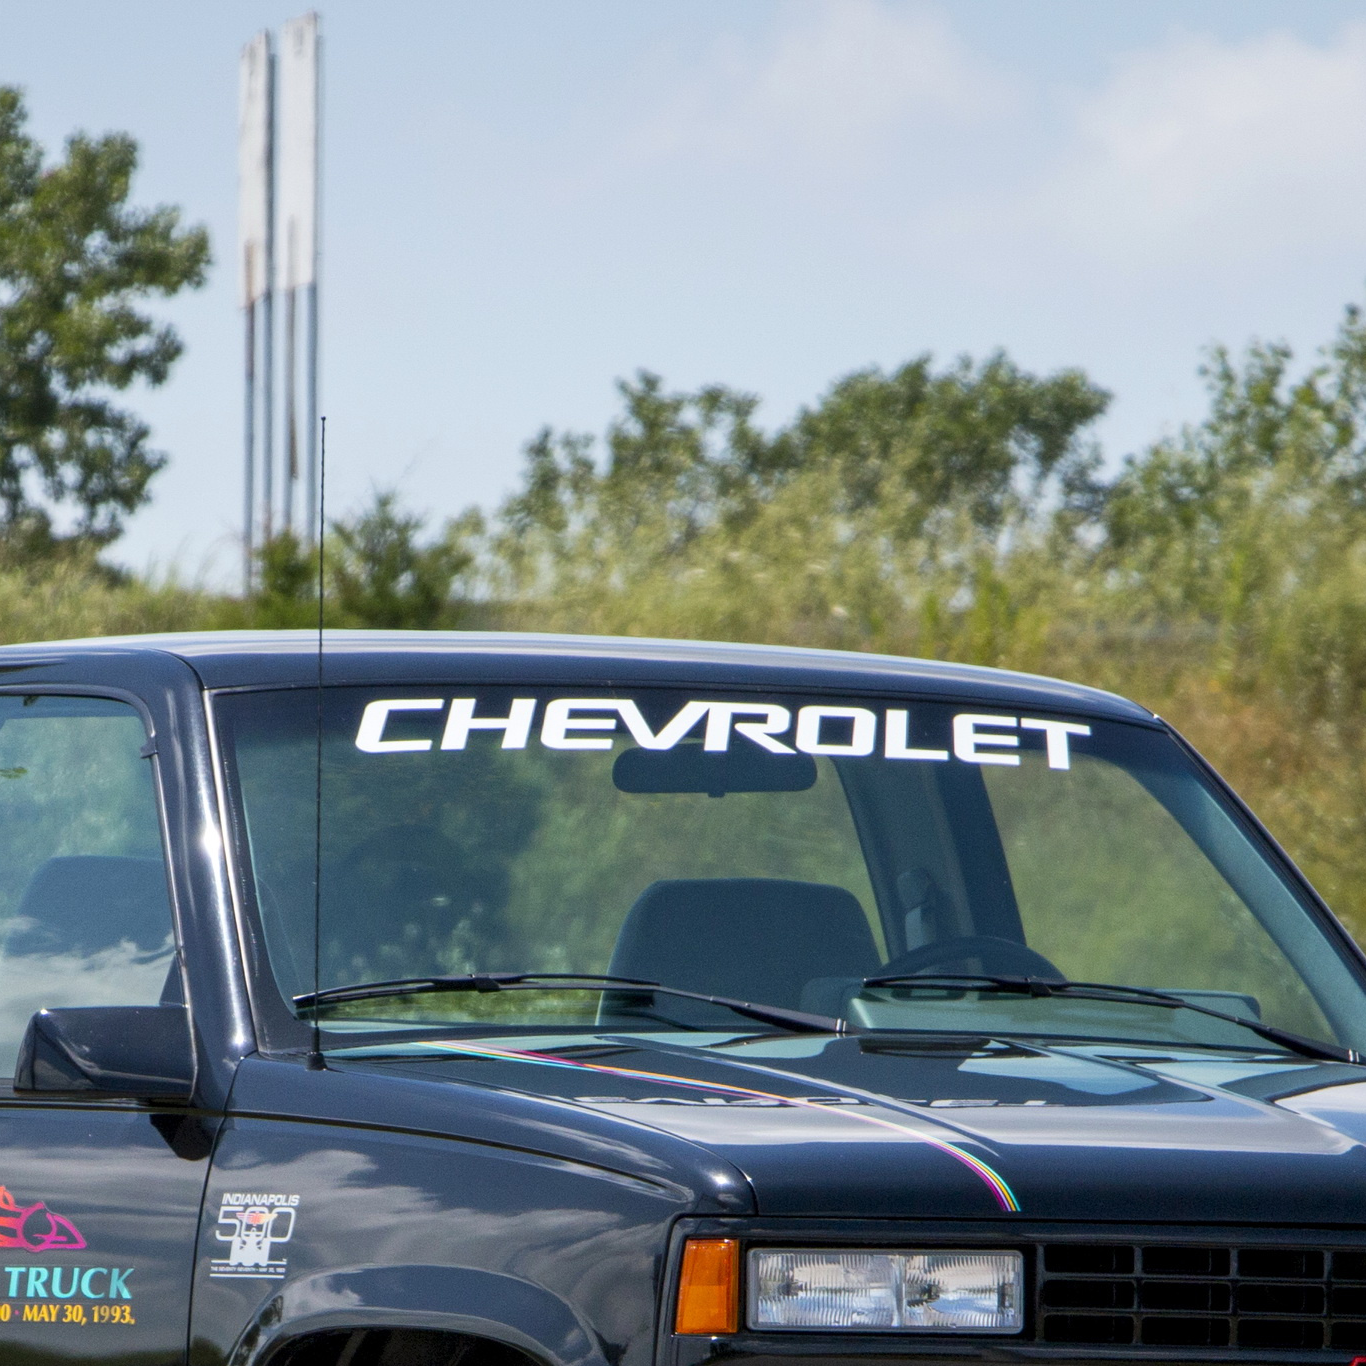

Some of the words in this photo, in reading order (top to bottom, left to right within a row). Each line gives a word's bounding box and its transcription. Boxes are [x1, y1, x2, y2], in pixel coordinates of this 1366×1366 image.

[355, 697, 1092, 770] CHEVROLET
[221, 1192, 300, 1206] INDIANAPOLIS
[215, 1206, 296, 1243] 500
[4, 1266, 135, 1299] TRUCK
[22, 1304, 61, 1323] MAY
[62, 1304, 88, 1326] 30,
